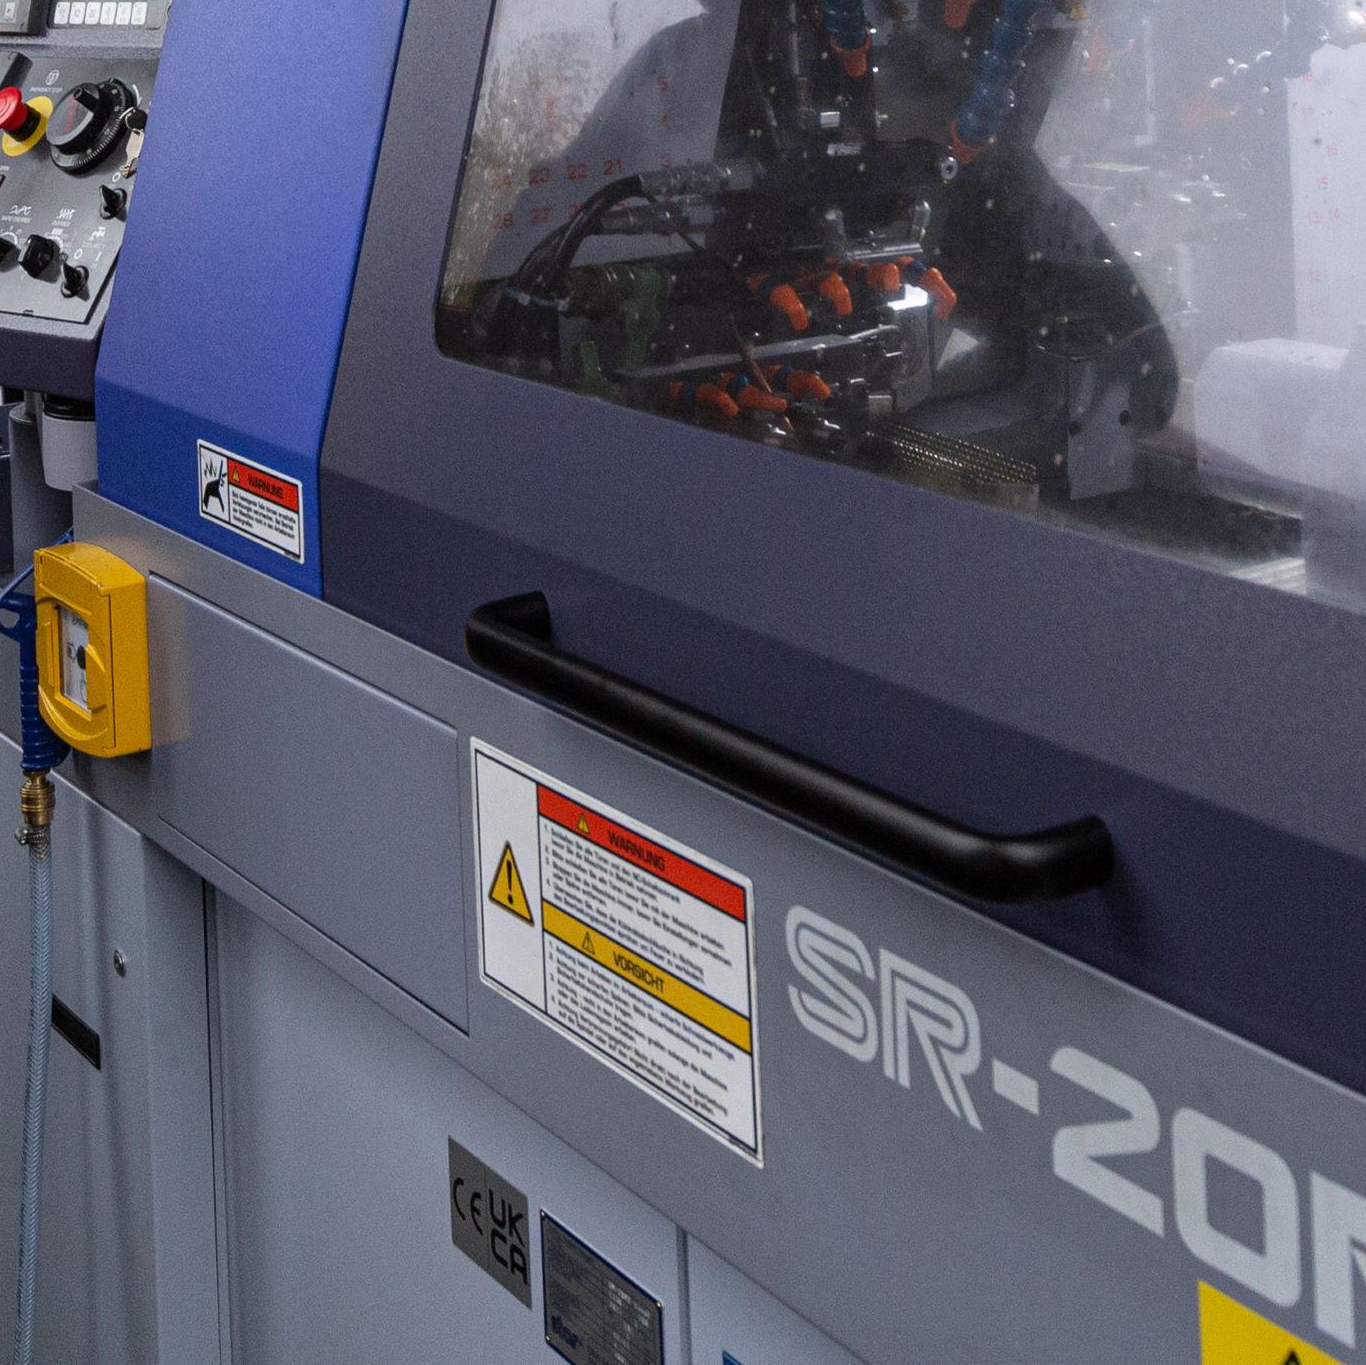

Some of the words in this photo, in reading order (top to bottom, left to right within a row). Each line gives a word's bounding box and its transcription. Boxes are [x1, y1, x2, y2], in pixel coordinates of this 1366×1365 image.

[607, 829, 666, 873] WARNUNG
[612, 950, 666, 995] VORSICHT
[452, 1177, 484, 1235] CE
[488, 1188, 526, 1248] UK
[490, 1228, 528, 1285] CA
